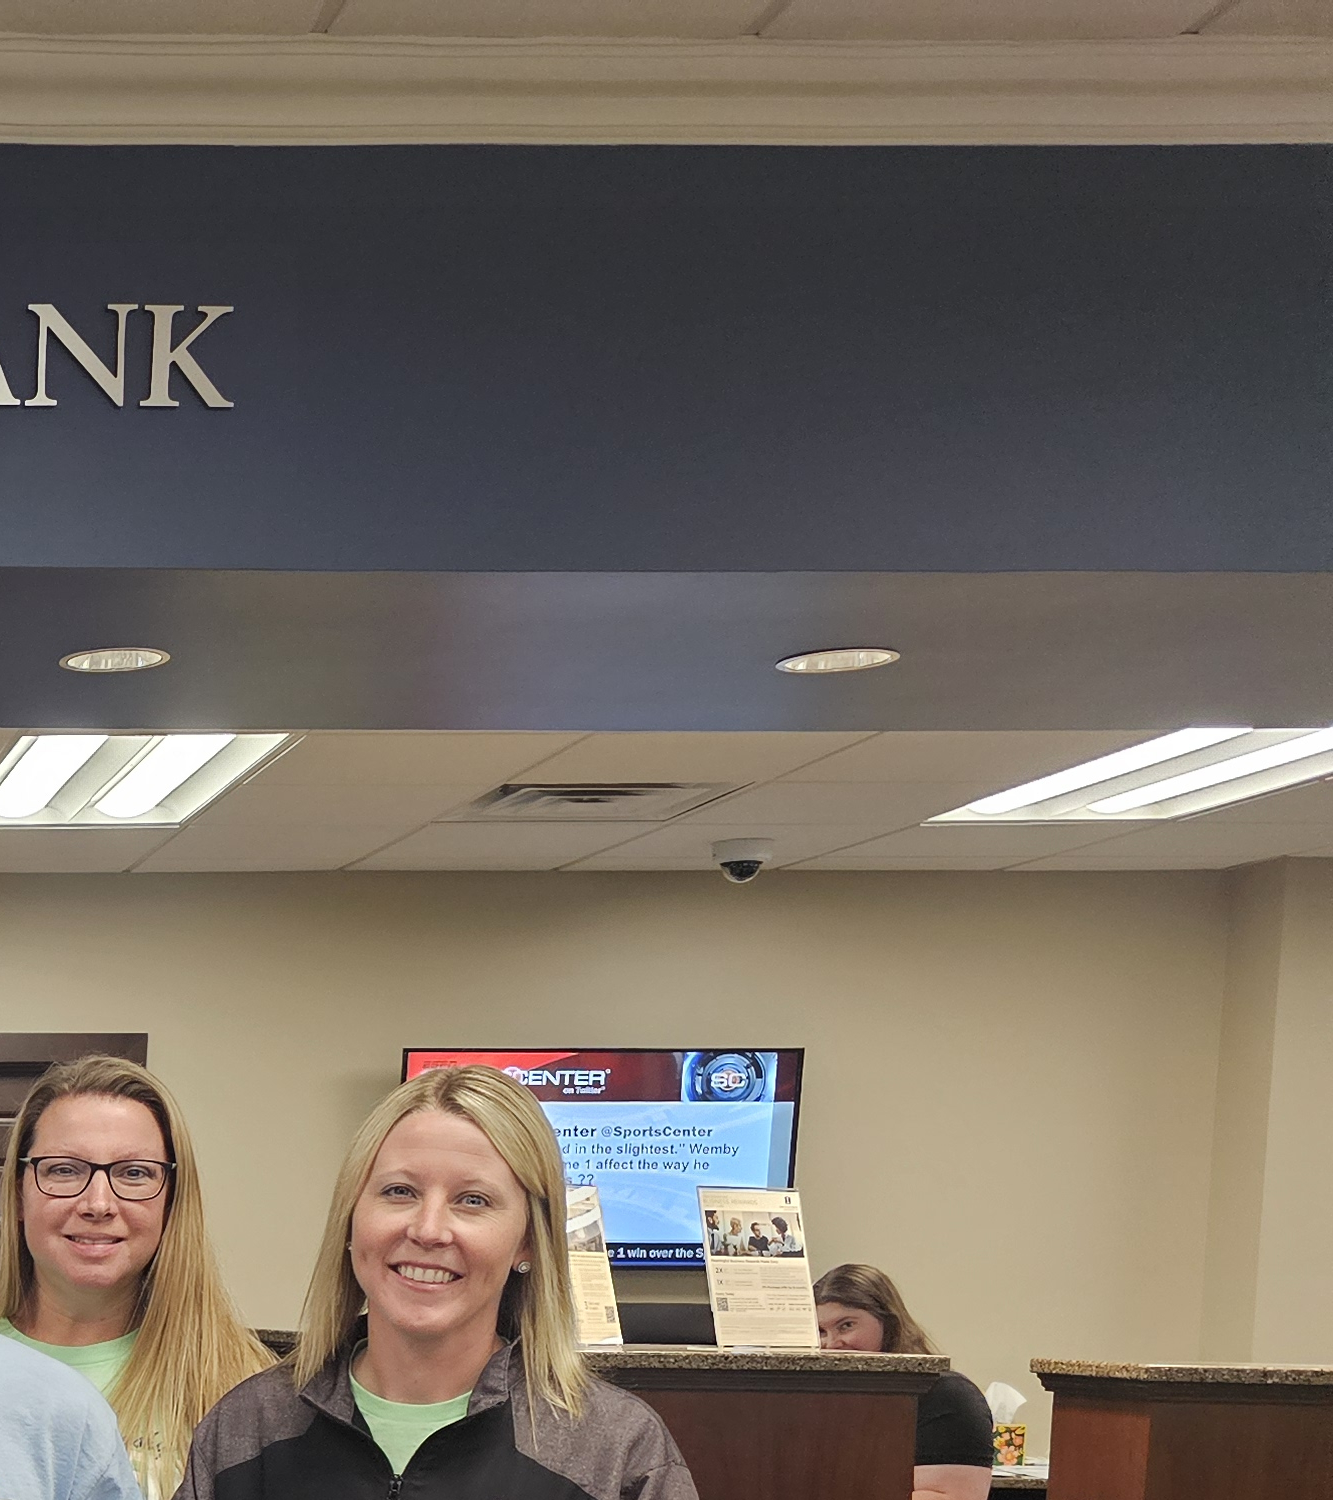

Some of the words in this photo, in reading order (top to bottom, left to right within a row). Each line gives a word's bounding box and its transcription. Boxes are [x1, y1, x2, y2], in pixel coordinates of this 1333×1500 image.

[553, 1125, 597, 1138] enter
[601, 1125, 713, 1139] @SportsCenter
[575, 1143, 587, 1155] in
[591, 1143, 612, 1155] the
[689, 1143, 740, 1157] Wemby
[585, 1159, 591, 1170] 1
[595, 1158, 634, 1170] affect
[637, 1158, 659, 1170] the
[662, 1160, 689, 1172] way
[693, 1158, 710, 1170] he
[617, 1247, 625, 1258] 1
[627, 1247, 647, 1258] win
[649, 1248, 673, 1258] over
[675, 1247, 694, 1258] the
